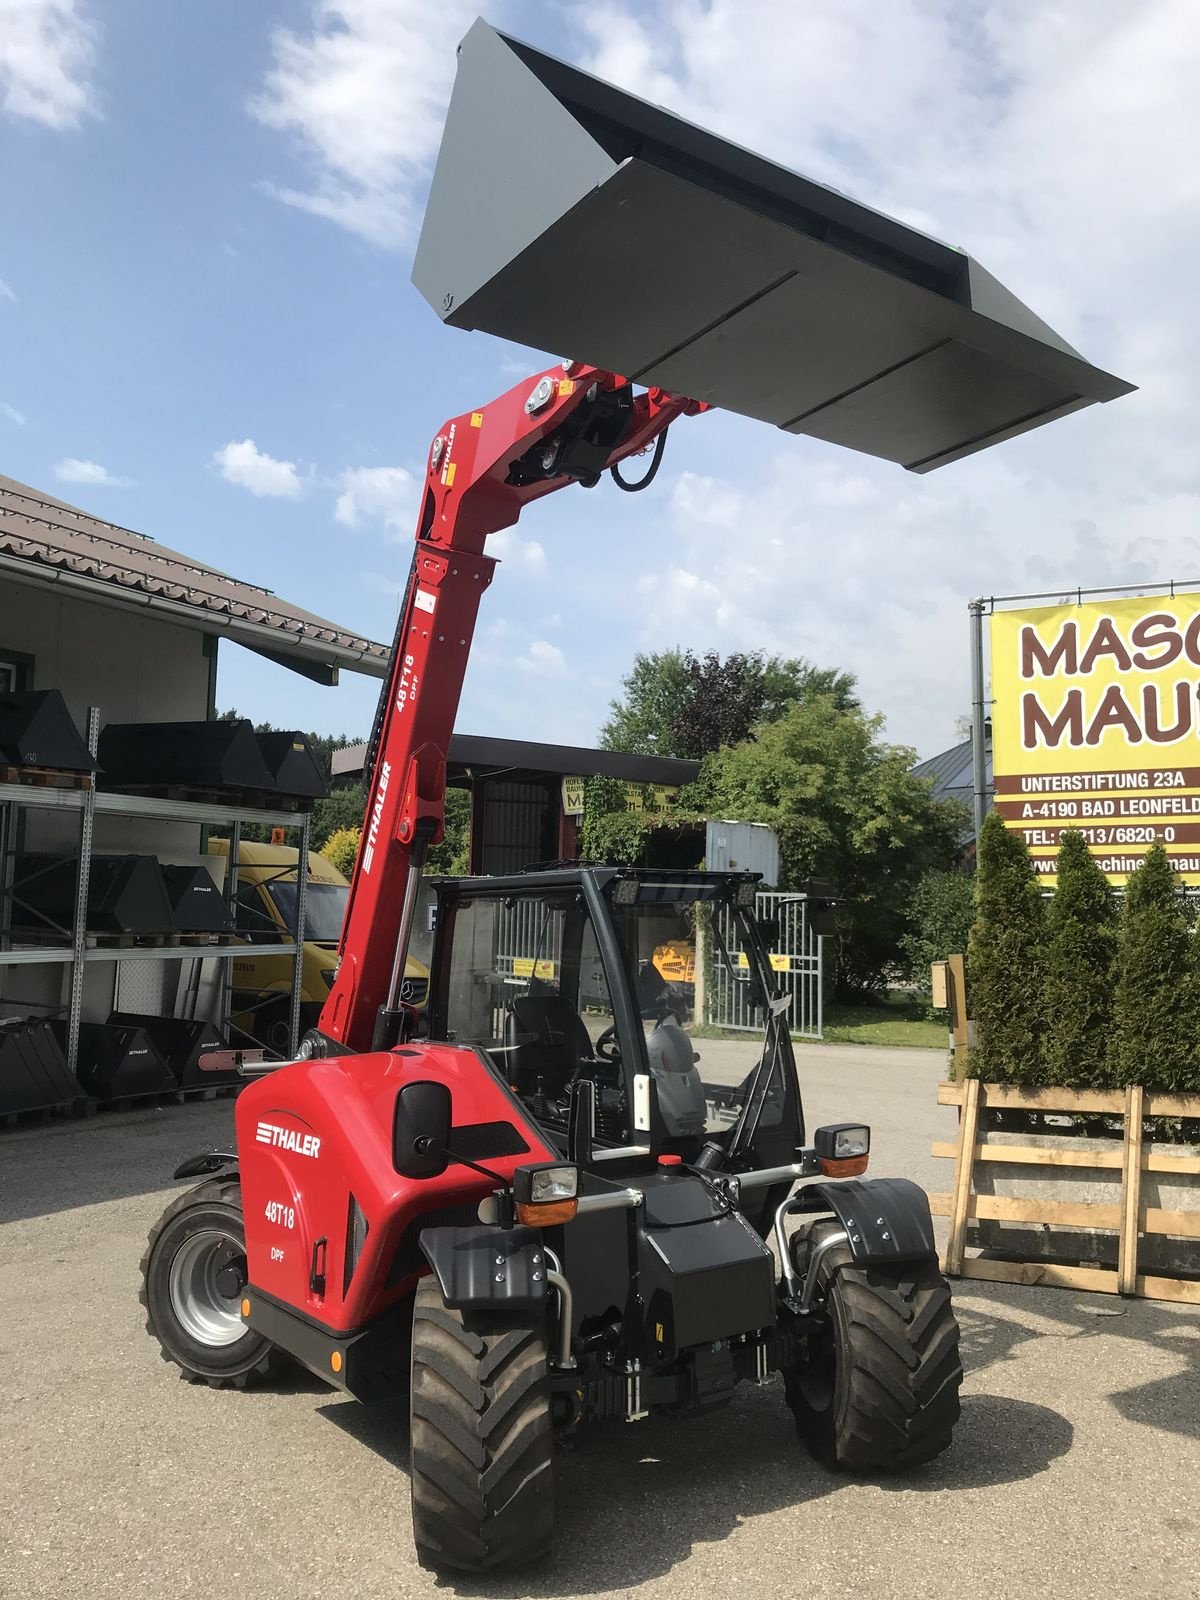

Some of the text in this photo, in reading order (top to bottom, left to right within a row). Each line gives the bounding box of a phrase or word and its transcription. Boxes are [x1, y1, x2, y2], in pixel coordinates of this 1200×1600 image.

[396, 654, 415, 713] 48T18
[409, 674, 420, 701] DPF
[1022, 682, 1200, 749] MAU
[1021, 770, 1186, 792] UNTERSTIFTUNG 23A
[1022, 801, 1077, 818] A-4190
[1082, 800, 1115, 816] BAD
[1023, 829, 1055, 845] TEL:
[264, 1200, 295, 1230] 48T18
[271, 1246, 285, 1263] DPF
